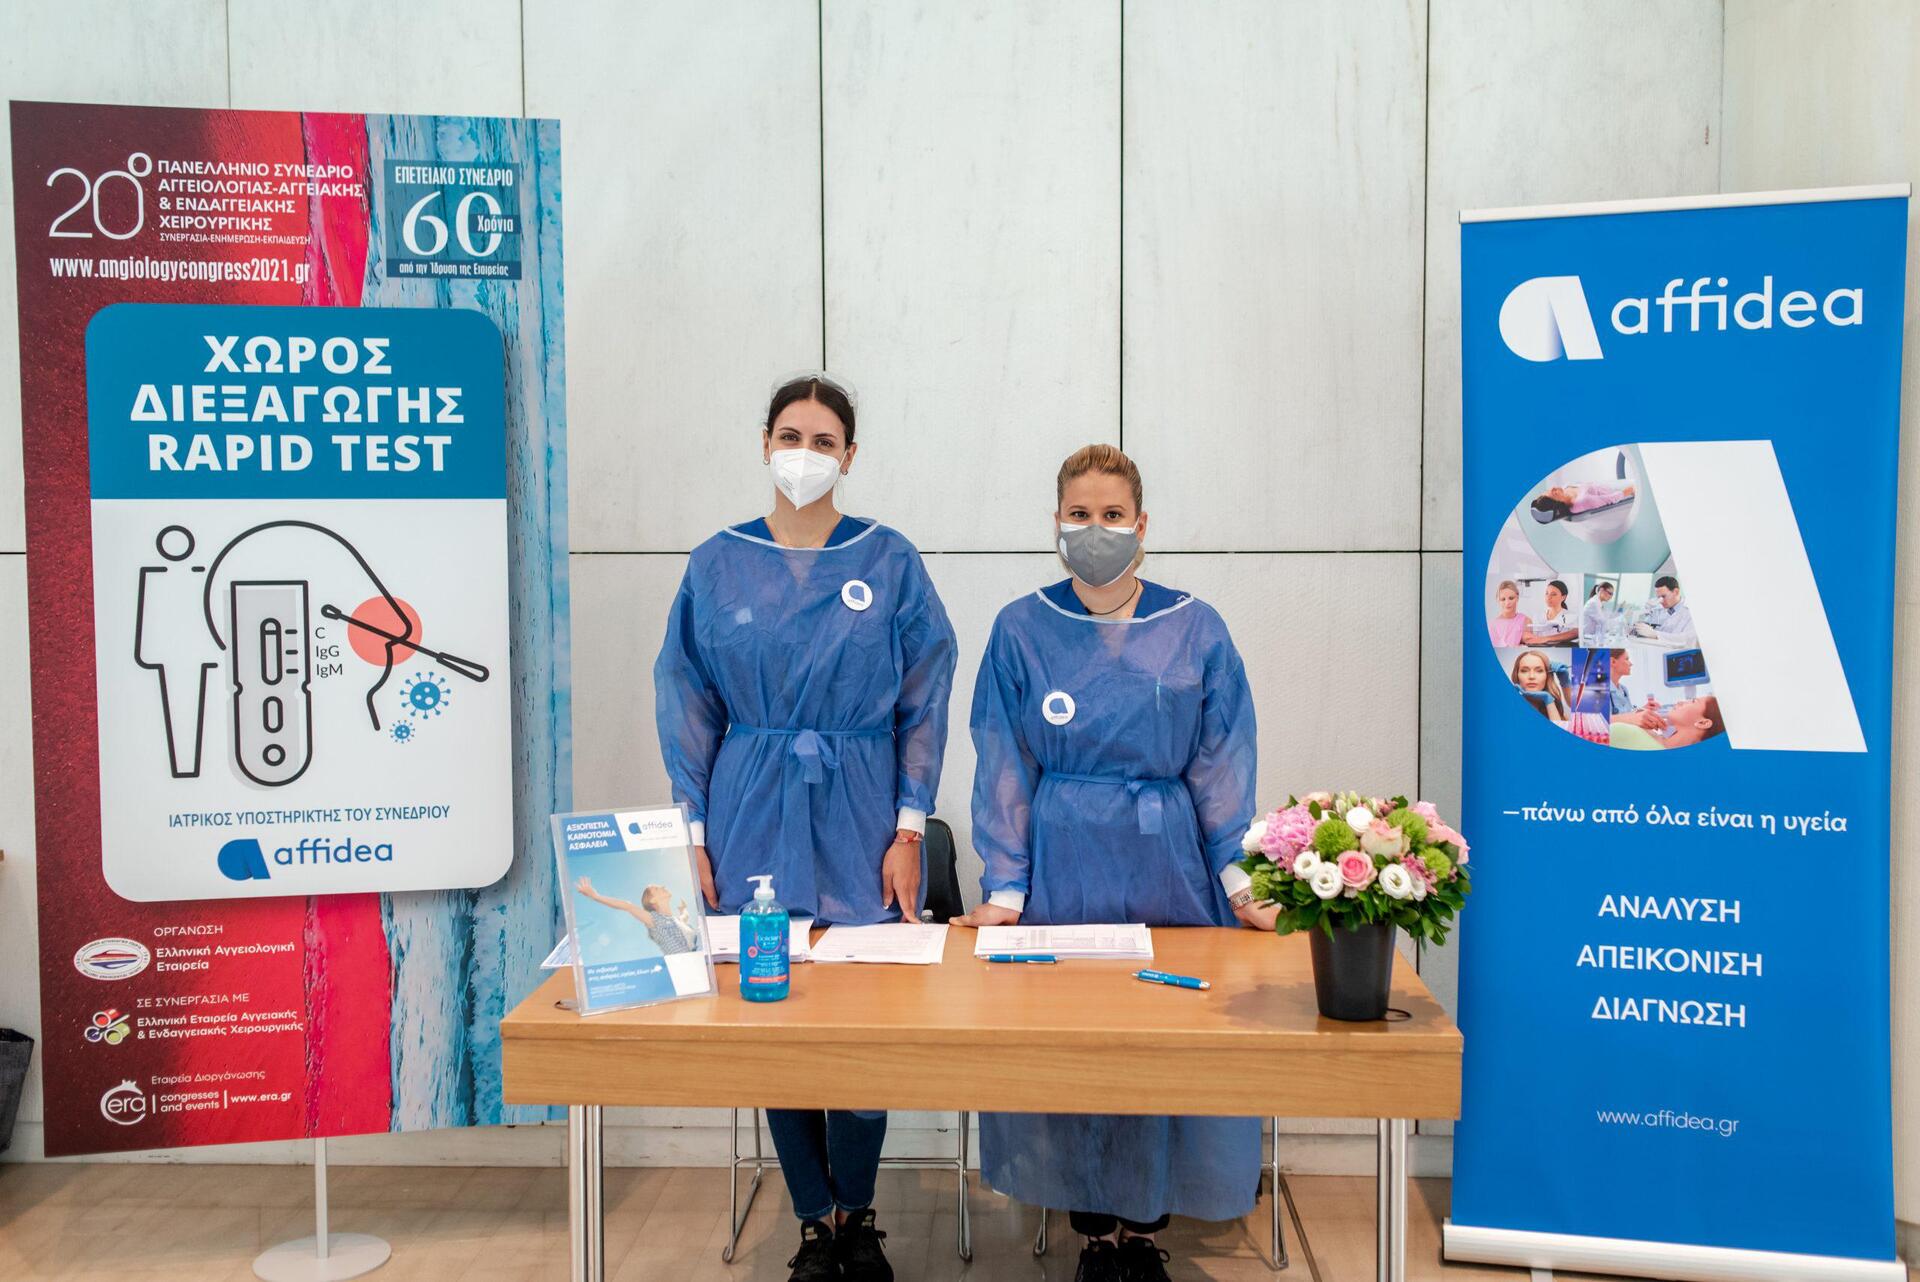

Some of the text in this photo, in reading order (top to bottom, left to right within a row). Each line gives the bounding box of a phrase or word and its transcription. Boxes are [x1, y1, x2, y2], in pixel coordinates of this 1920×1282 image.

[158, 160, 353, 179] ΠΑΝΕΛΛΗΝΙΟ ΣΥΝΕΔΡΙΟ
[395, 166, 513, 186] ΕΠΕΤΕΙΑΚΟ ΣΥΝΕΔΡΙΟ
[158, 179, 363, 197] ΑΓΓΕΙΟΛΟΓΙΑΣ-ΑΓΓΕΙΑΚΗΣ
[159, 197, 296, 213] & ΕΝΔΑΓΓΕΙΑΚΗΣ
[159, 215, 272, 231] ΧΕΙΡΟΥΡΓΙΚΗΣ
[403, 191, 502, 257] 60
[477, 214, 514, 233] Χρόνια
[50, 256, 310, 284] www.angiologycongress2021.gr
[399, 261, 413, 273] από
[416, 263, 427, 275] την
[460, 264, 471, 276] της
[473, 262, 509, 277] Εταιρείας
[1611, 275, 1863, 335] affidea
[203, 335, 392, 374] ΧΩΡΟΣ
[130, 384, 465, 424] ΔΙΕΞΑΓΩΓΗΣ
[148, 434, 452, 472] RAPID TEST
[315, 627, 326, 639] C
[316, 645, 340, 659] IgG
[316, 663, 343, 677] IgM
[169, 805, 450, 828] ΙΑΤΡΙΚΟΣ ΥΠΟΣΤΗΡΙΚΤΗΣ ΤΟΥ ΣΥΝΕΔΡΙΟΥ
[1591, 803, 1638, 825] από
[1645, 805, 1690, 826] όλα
[1698, 806, 1753, 830] είναι
[1761, 814, 1776, 834] η
[1783, 810, 1847, 836] υγεία
[566, 821, 609, 832] ΑΞΙΟΠΙΣΤΙΑ
[642, 821, 673, 831] affidea
[567, 830, 617, 841] ΚΑΙΝΟΤΟΜΙΑ
[274, 837, 393, 865] affidea
[569, 840, 609, 851] ΑΣΦΑΛΕΙΑ
[1598, 895, 1741, 923] ΑΝΑΛΥΣΗ
[153, 925, 223, 937] ΟΡΓΑΝΩΣΗ
[156, 945, 211, 958] Ελληνική
[215, 941, 295, 957] Αγγειολογική
[157, 959, 209, 972] Εταιρεία
[1576, 945, 1763, 976] ΑΠΕΙΚΟΝΙΣΗ
[137, 993, 249, 1008] ΣΕ ΣΥΝΕΡΓΑΣΙΑ ΜΕ
[137, 1010, 297, 1027] Ελληνική Εταιρεία Αγγειακής
[1591, 996, 1746, 1027] ΔΙΑΓΝΩΣΗ
[137, 1022, 304, 1040] & Ενδαγγειακής Χειρουργικής
[151, 1074, 192, 1086] Εταιρεία
[107, 1095, 146, 1114] era
[160, 1090, 219, 1103] congresses
[231, 1091, 292, 1103] www.era.gr
[160, 1101, 220, 1113] and events
[1596, 1109, 1739, 1137] www.affidea.gr
